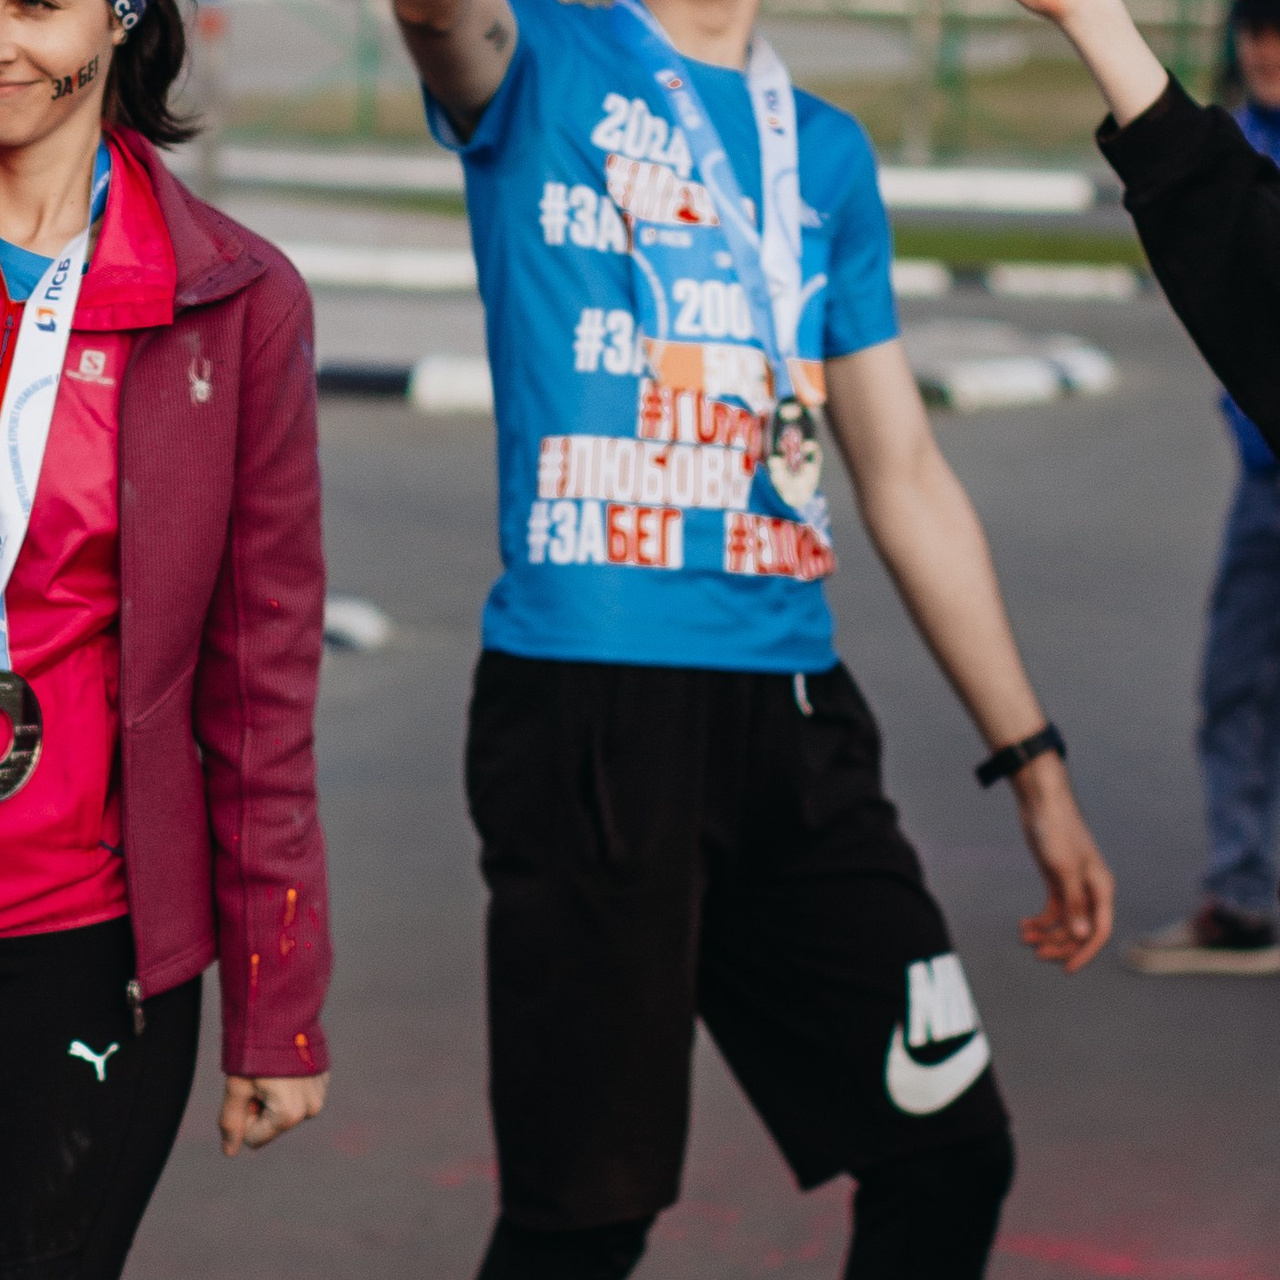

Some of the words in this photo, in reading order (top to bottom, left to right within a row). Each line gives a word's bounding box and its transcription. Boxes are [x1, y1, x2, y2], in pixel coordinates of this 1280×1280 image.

[591, 92, 693, 180] 2024
[44, 258, 71, 301] ПСБ
[539, 435, 752, 509] #ЛЮБОВЬ
[528, 501, 680, 567] #ЗАБЕГ
